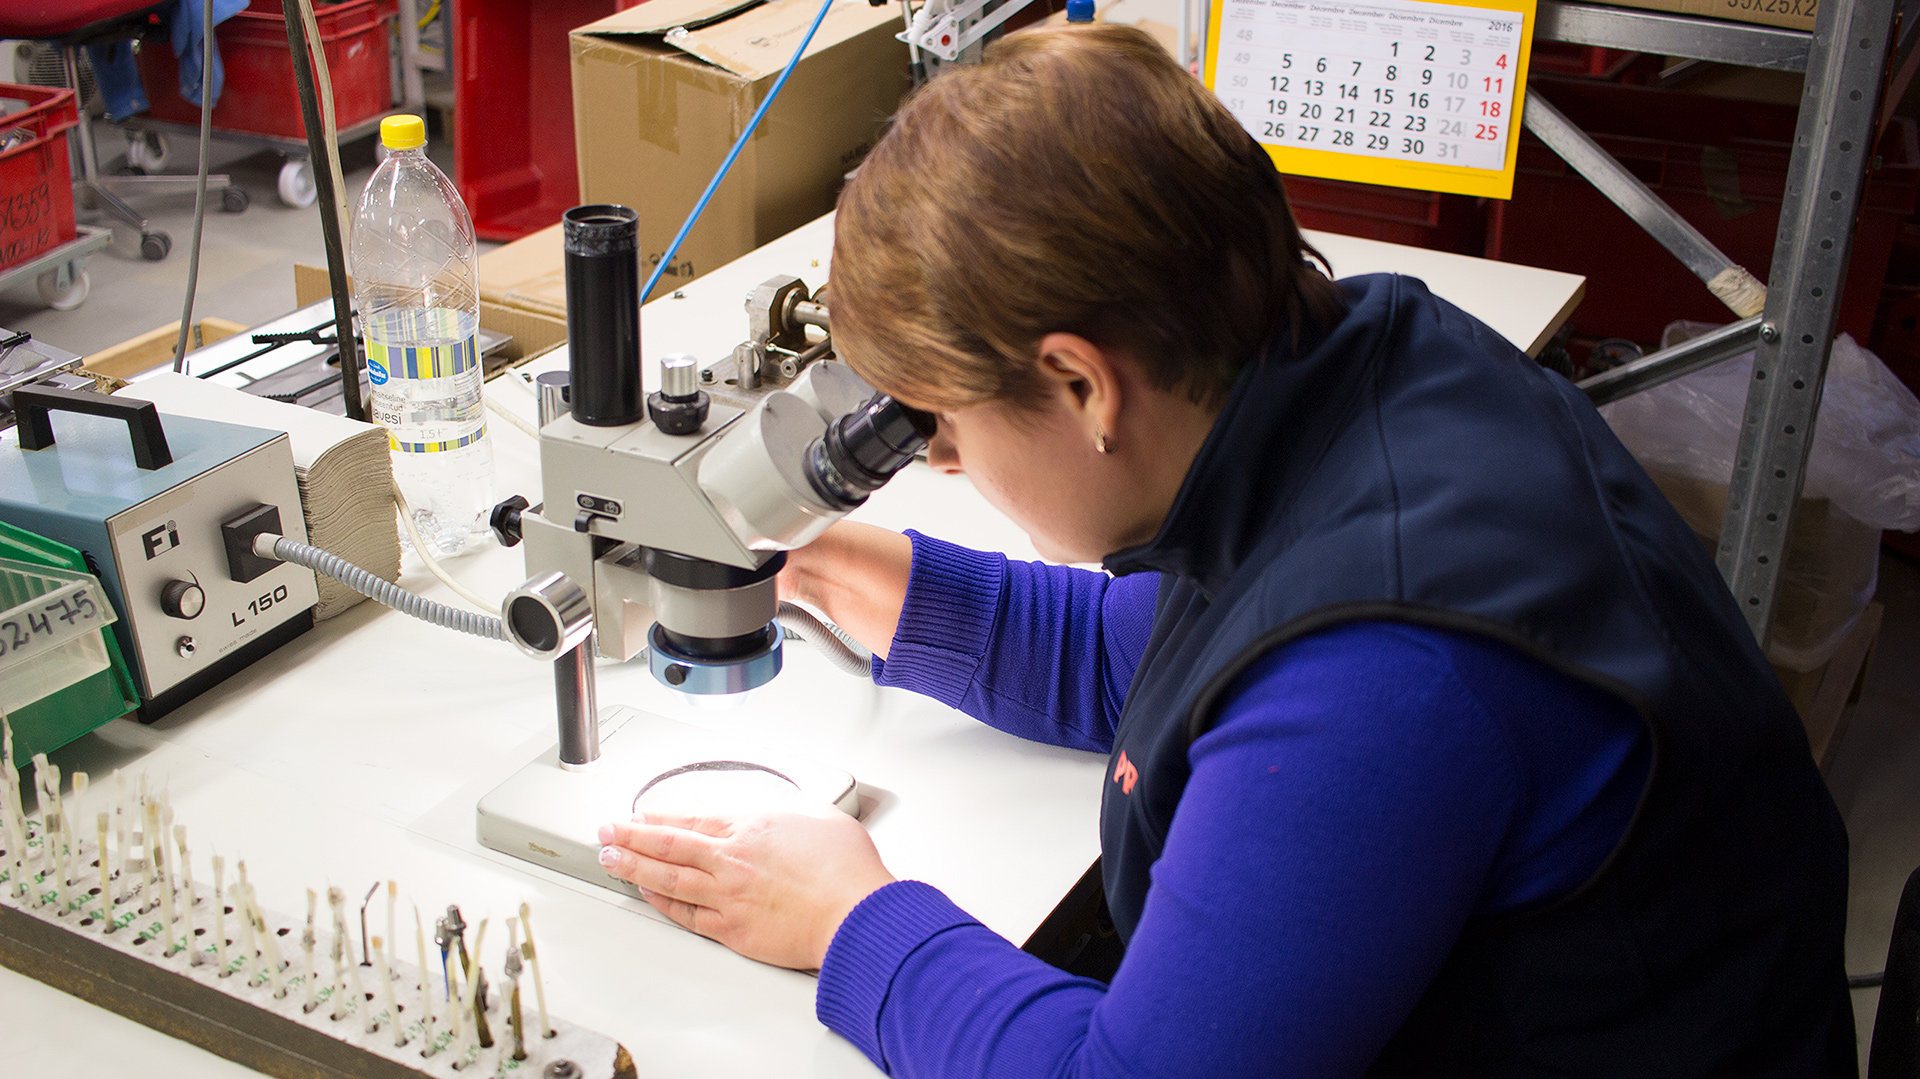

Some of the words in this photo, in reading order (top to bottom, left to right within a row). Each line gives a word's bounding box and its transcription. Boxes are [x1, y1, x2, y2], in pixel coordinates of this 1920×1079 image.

[1488, 21, 1513, 32] 2016
[1236, 29, 1254, 42] 48
[1391, 42, 1399, 58] 1
[1424, 45, 1436, 62] 2
[1459, 49, 1473, 66] 3
[1495, 54, 1508, 70] 4
[1233, 53, 1251, 65] 49
[1282, 54, 1293, 70] 5
[1316, 57, 1327, 74] 6
[1352, 61, 1363, 77] 7
[1385, 65, 1398, 82] 8
[1421, 69, 1433, 86] 9
[1447, 72, 1469, 90] 10
[1483, 77, 1503, 94] 11
[1231, 75, 1249, 89] 50
[1270, 76, 1290, 93] 12
[1304, 80, 1325, 97] 13
[1339, 84, 1359, 101] 14
[1373, 88, 1394, 105] 15
[1408, 92, 1430, 109] 16
[1443, 96, 1466, 114] 17
[1480, 101, 1502, 118] 18
[1227, 98, 1245, 113] 51
[1267, 99, 1288, 116] 19
[1299, 103, 1322, 120] 20
[1334, 107, 1355, 124] 21
[1368, 111, 1391, 129] 22
[1403, 115, 1427, 133] 23
[1438, 119, 1463, 138] 24
[1474, 124, 1498, 141] 25
[1263, 122, 1285, 139] 26
[1297, 126, 1320, 142] 27
[1331, 130, 1354, 147] 28
[1366, 134, 1389, 151] 29
[1401, 138, 1425, 155] 30
[1436, 142, 1459, 160] 31
[231, 610, 246, 628] L
[247, 584, 289, 616] 150
